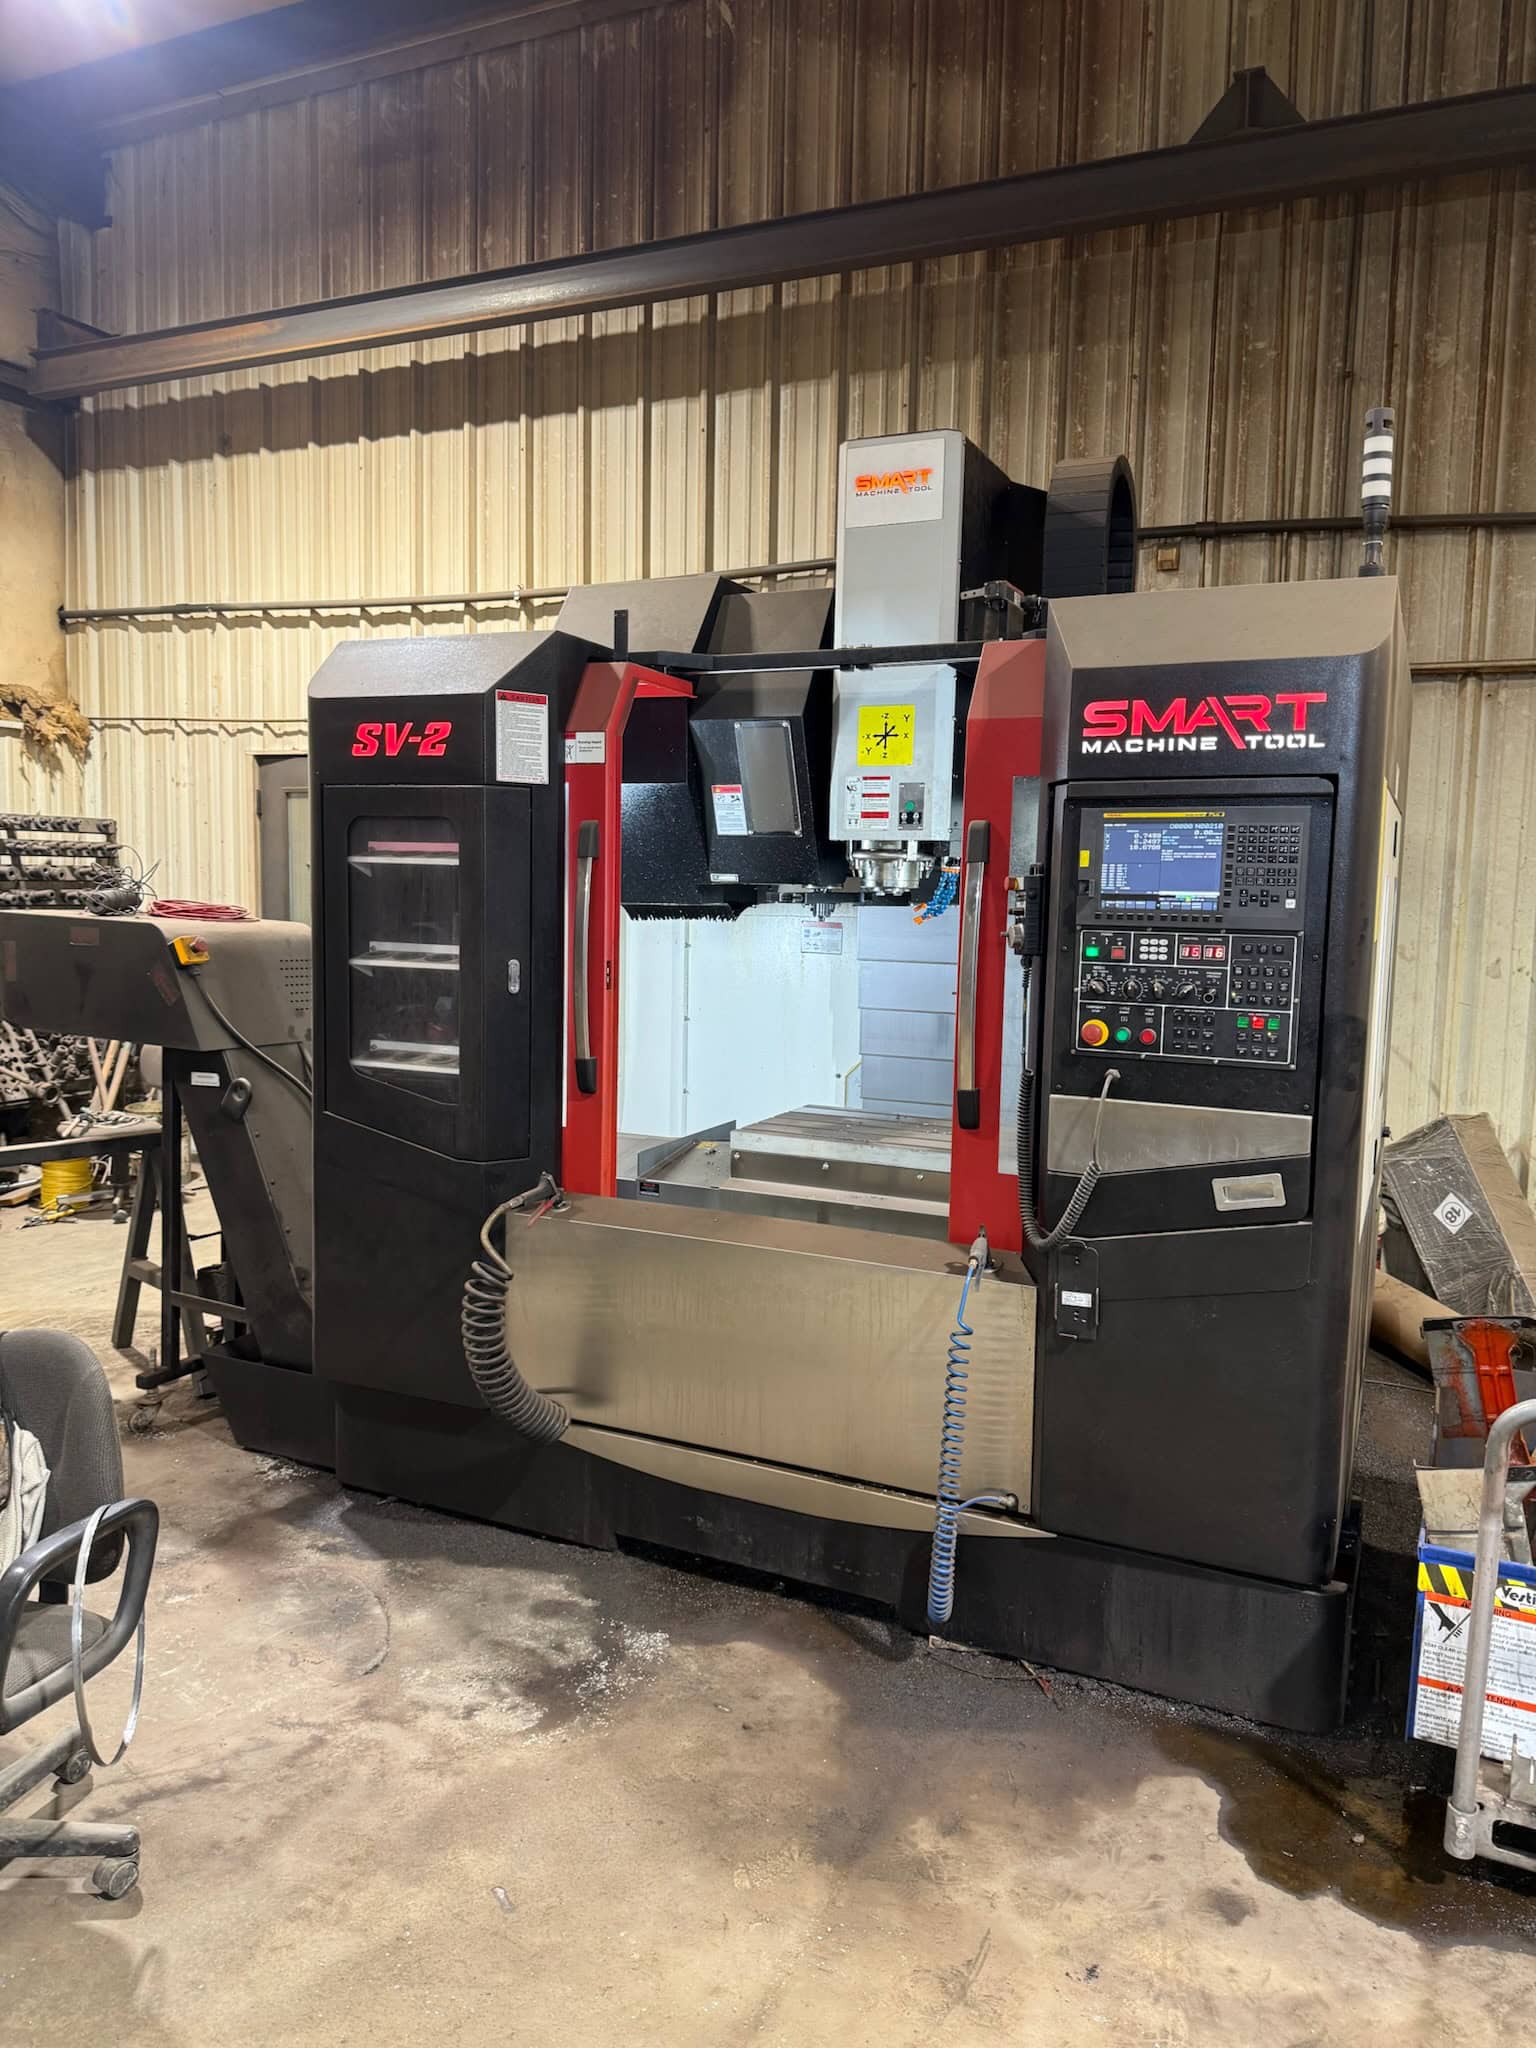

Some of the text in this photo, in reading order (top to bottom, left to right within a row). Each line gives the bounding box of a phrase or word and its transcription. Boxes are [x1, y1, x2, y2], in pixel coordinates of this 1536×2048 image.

[855, 468, 934, 494] SMART
[855, 488, 900, 497] MACHINE
[904, 714, 910, 722] Y
[1082, 692, 1328, 750] SMART
[352, 722, 452, 757] SV-2
[1082, 733, 1326, 754] MACHINE TOOL
[1183, 946, 1200, 957] 15
[1207, 947, 1223, 958] 16
[1444, 1206, 1461, 1223] 18
